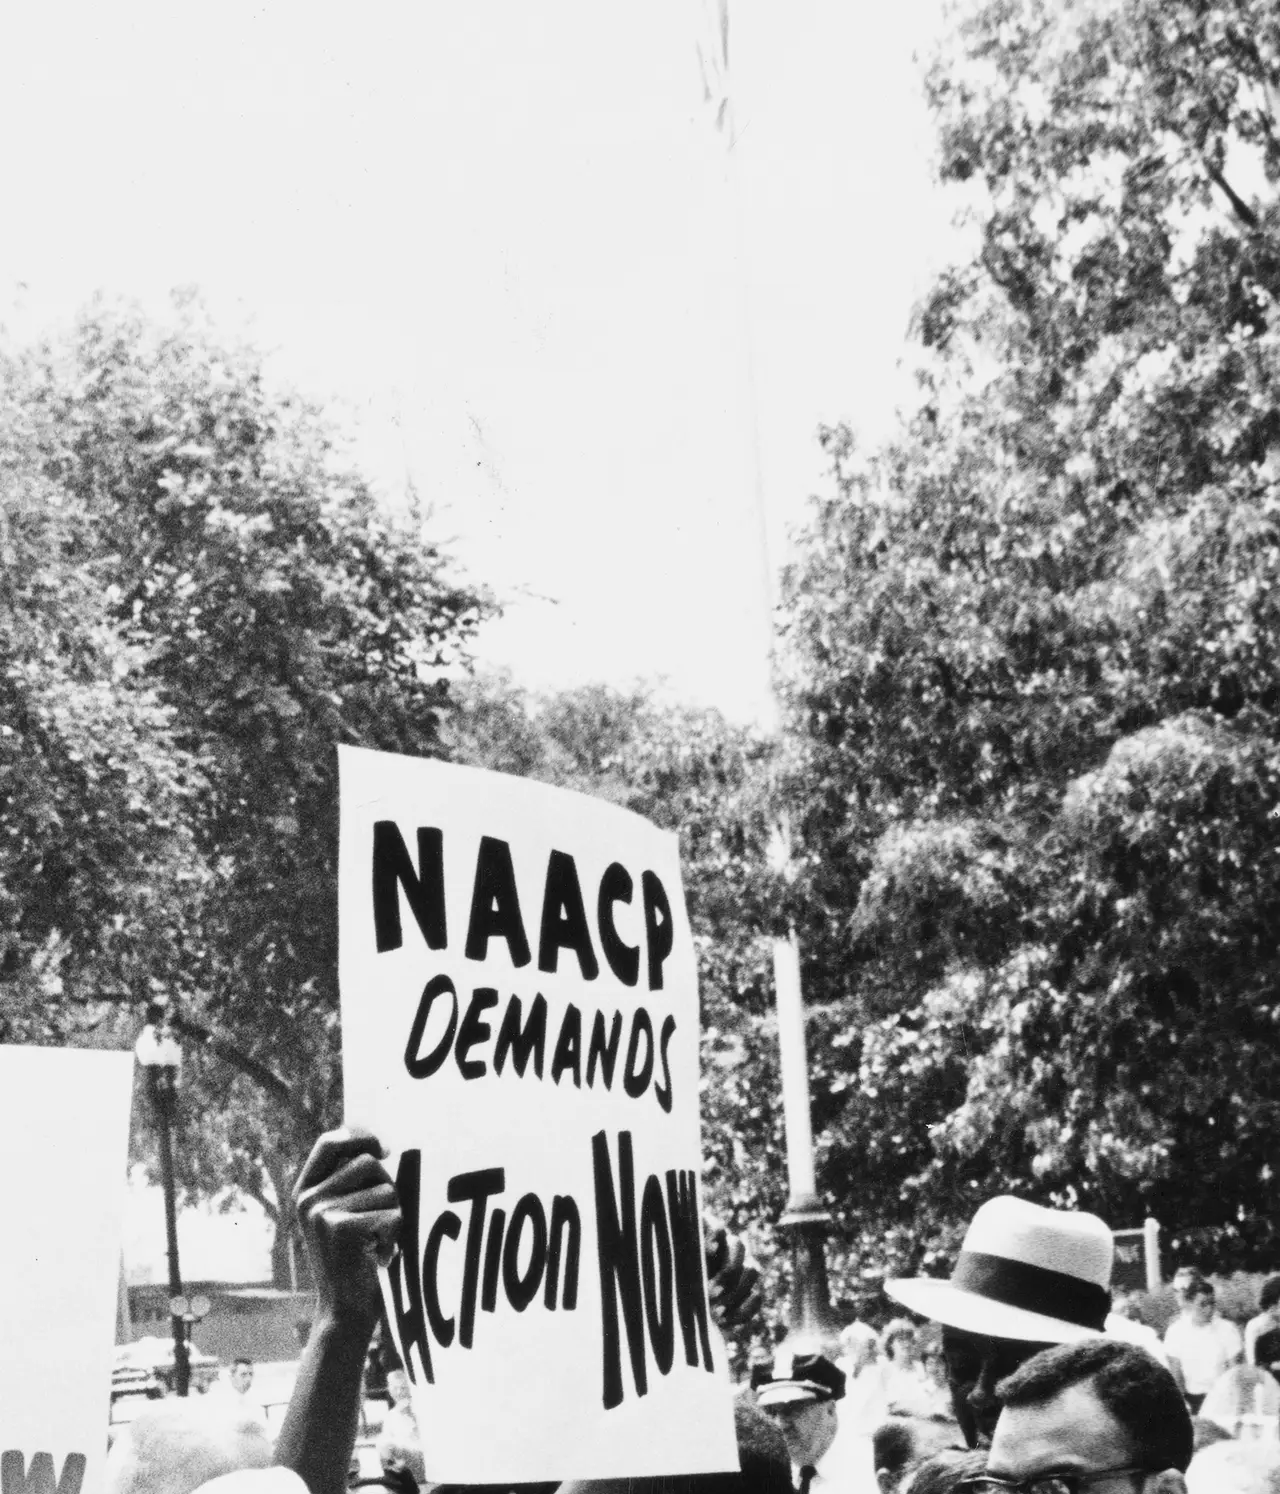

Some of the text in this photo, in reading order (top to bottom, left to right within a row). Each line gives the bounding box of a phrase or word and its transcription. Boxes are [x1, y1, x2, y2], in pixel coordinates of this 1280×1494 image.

[371, 819, 676, 992] NAACP
[403, 973, 676, 1113] DEMANDS
[590, 1129, 715, 1411] NOW
